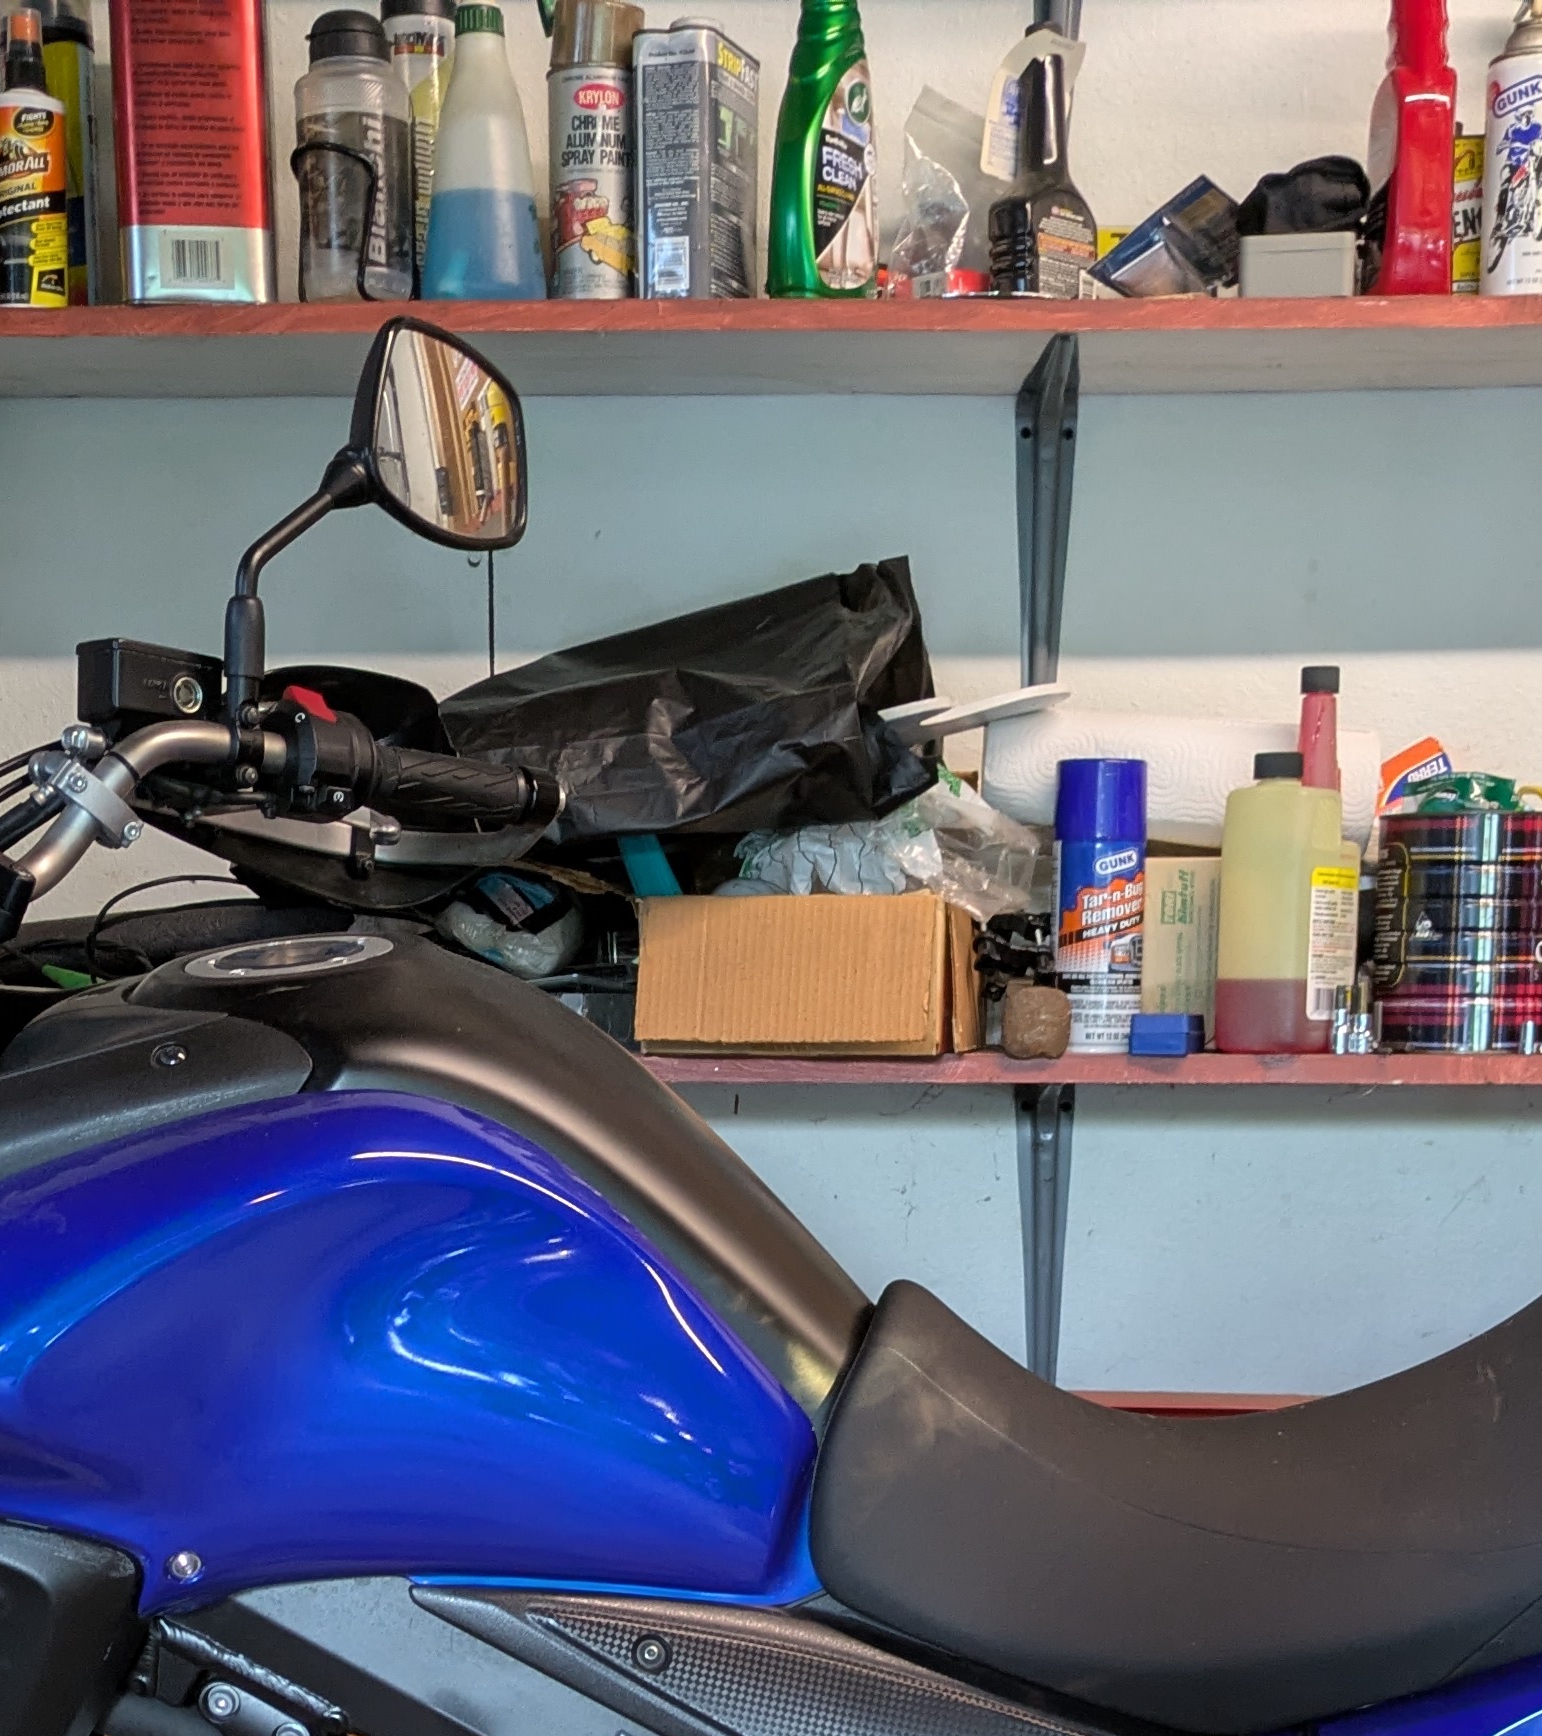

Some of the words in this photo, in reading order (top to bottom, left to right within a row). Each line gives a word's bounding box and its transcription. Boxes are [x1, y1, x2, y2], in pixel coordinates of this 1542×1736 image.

[578, 91, 620, 105] KRYLON
[1497, 80, 1542, 112] GUNK
[561, 150, 596, 168] SPRAY
[822, 146, 863, 180] FRESH
[822, 166, 858, 192] CLEAN
[1099, 853, 1135, 872] GUNK
[1082, 898, 1143, 927] Remover
[1082, 922, 1119, 939] HEAVY
[1120, 915, 1141, 928] DUTY
